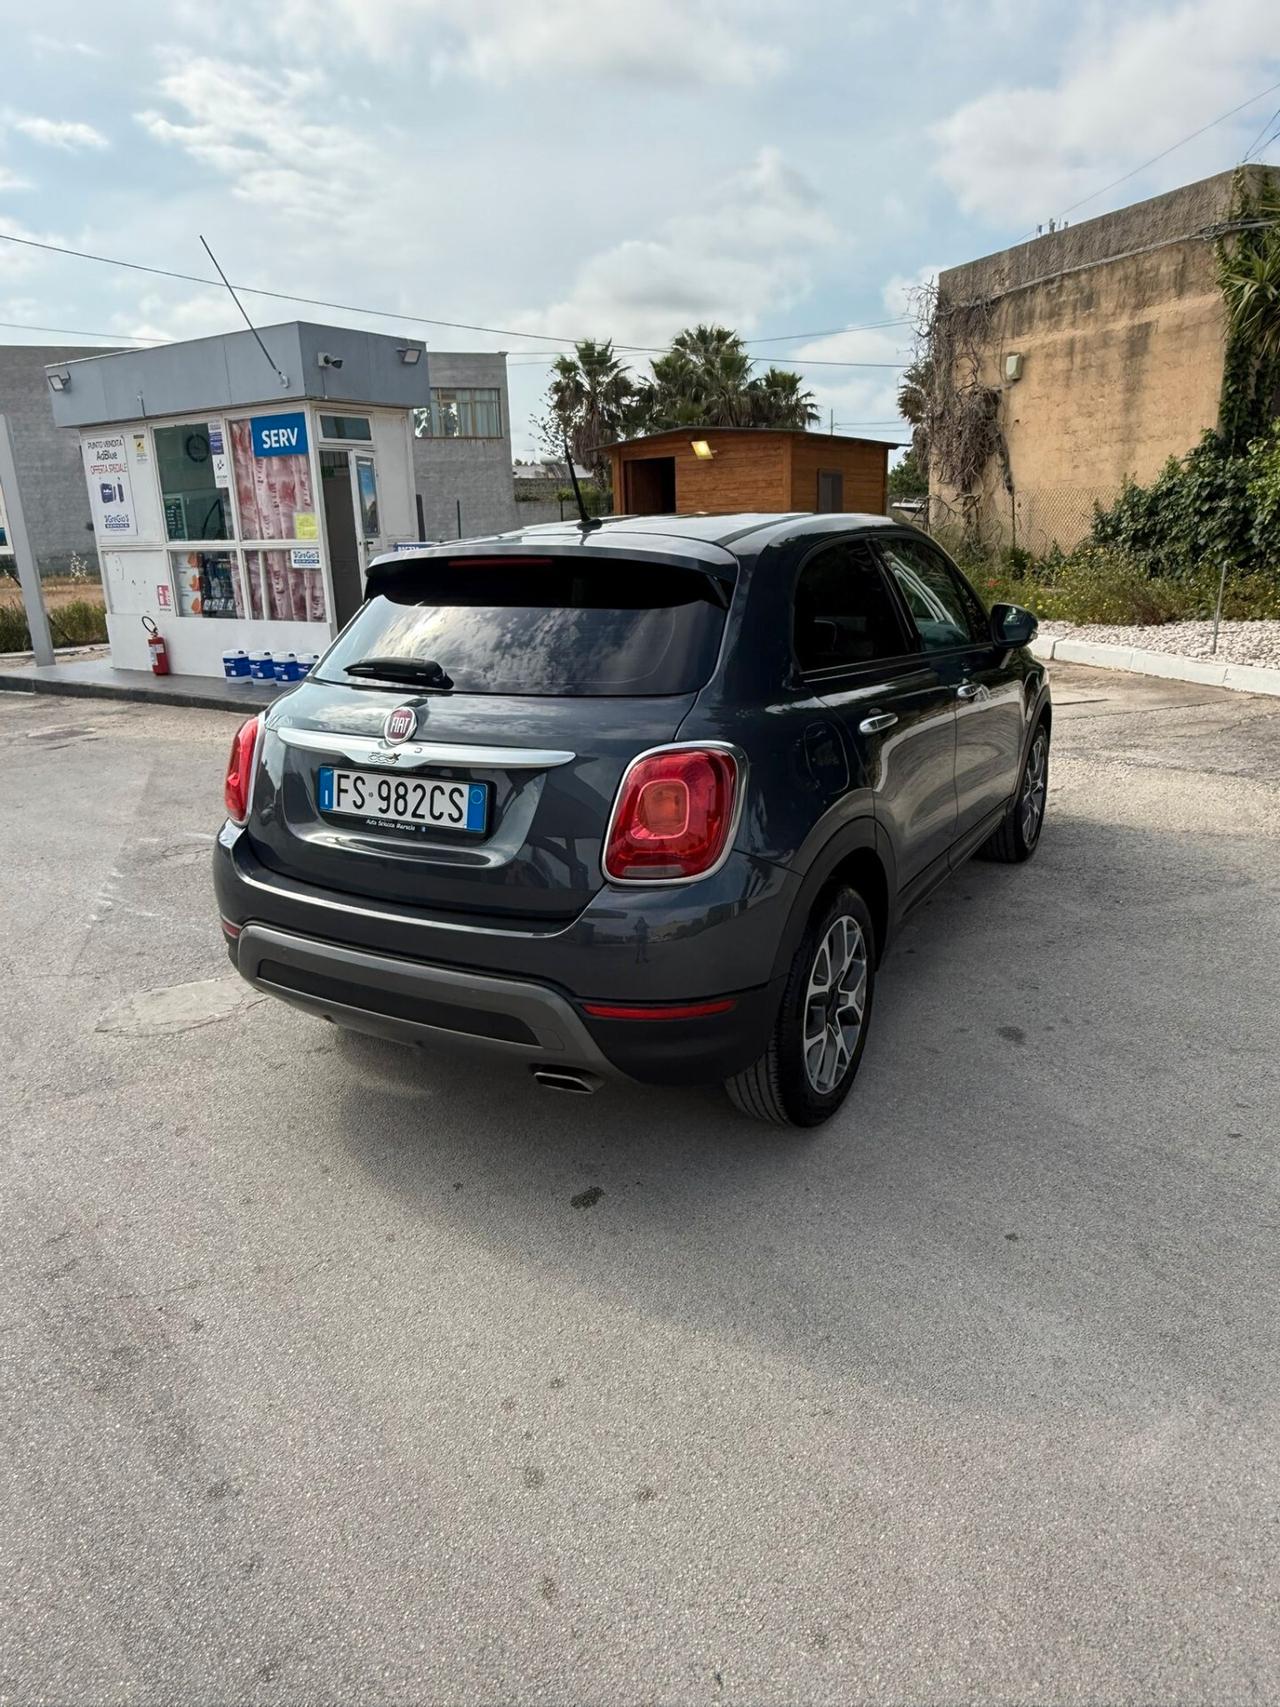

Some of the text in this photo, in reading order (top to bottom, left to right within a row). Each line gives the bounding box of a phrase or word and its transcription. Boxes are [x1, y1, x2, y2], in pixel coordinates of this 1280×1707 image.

[261, 427, 298, 449] SERV
[96, 449, 118, 460] AdBlue
[390, 717, 410, 733] FIAT
[337, 774, 366, 809] FS
[377, 779, 465, 823] 982CS
